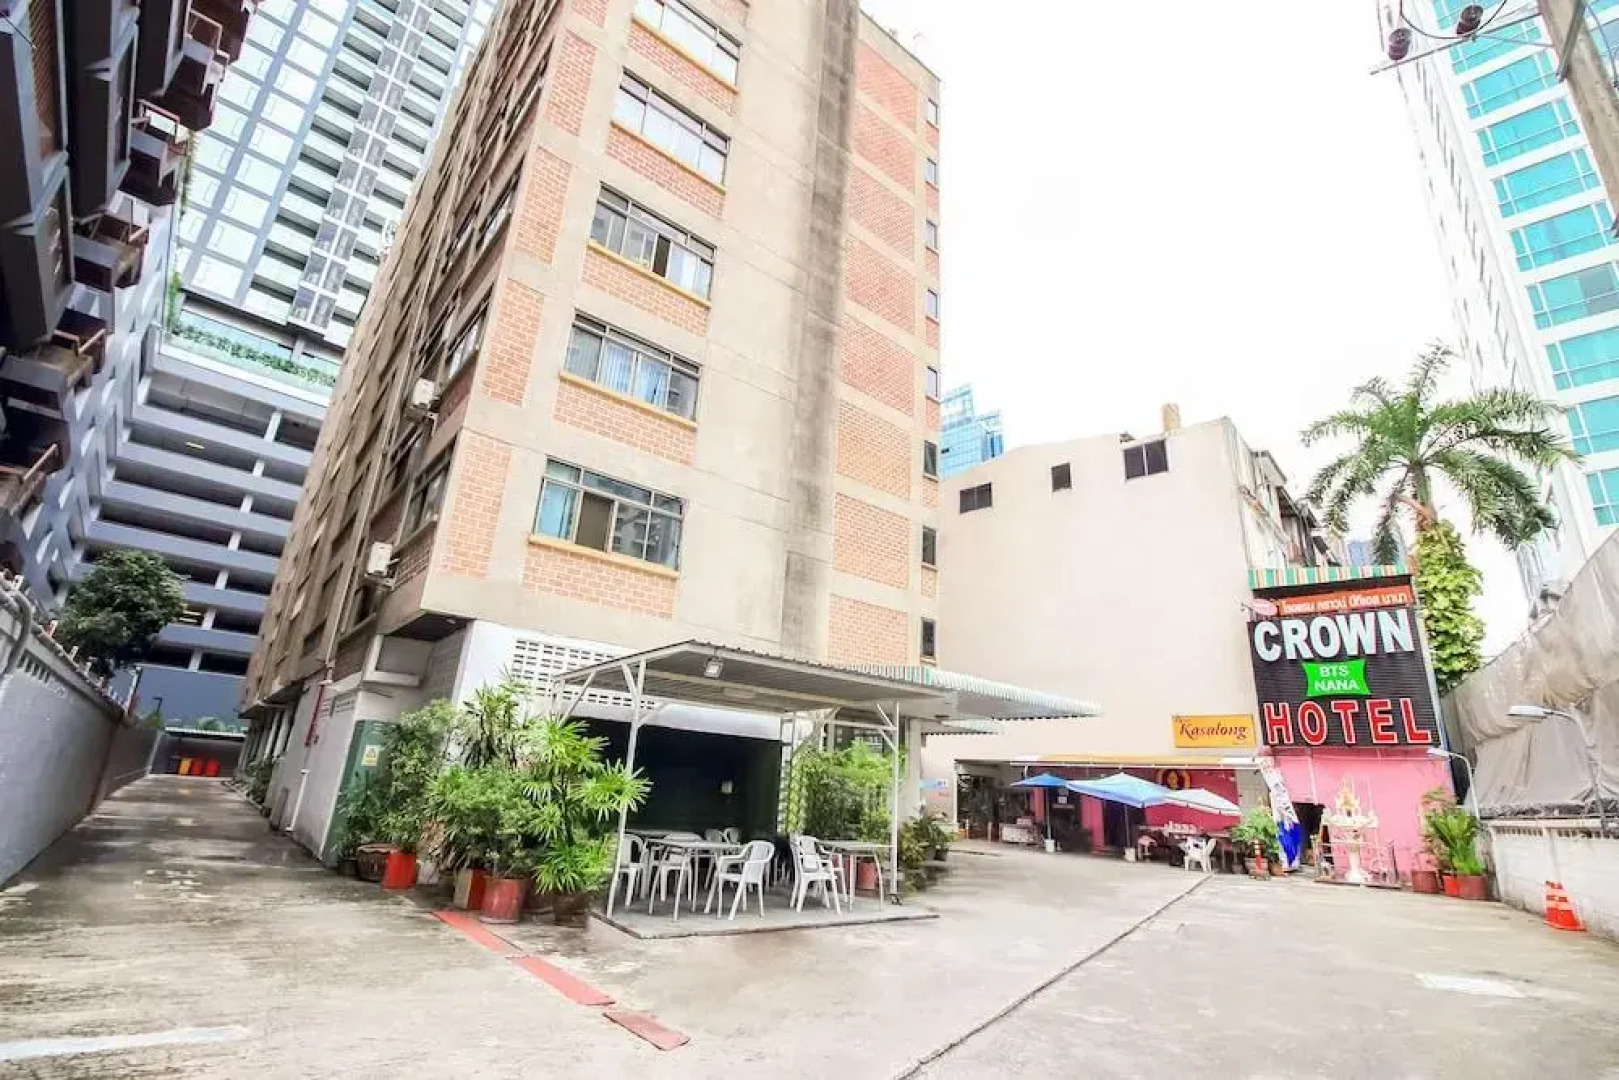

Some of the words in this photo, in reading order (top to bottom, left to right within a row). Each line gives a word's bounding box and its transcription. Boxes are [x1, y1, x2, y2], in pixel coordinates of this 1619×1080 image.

[1254, 609, 1415, 662] CROWN
[1319, 664, 1349, 676] BTS
[1314, 679, 1359, 692] NANA
[1180, 721, 1248, 740] Kasalong
[1263, 698, 1432, 746] HOTEL
